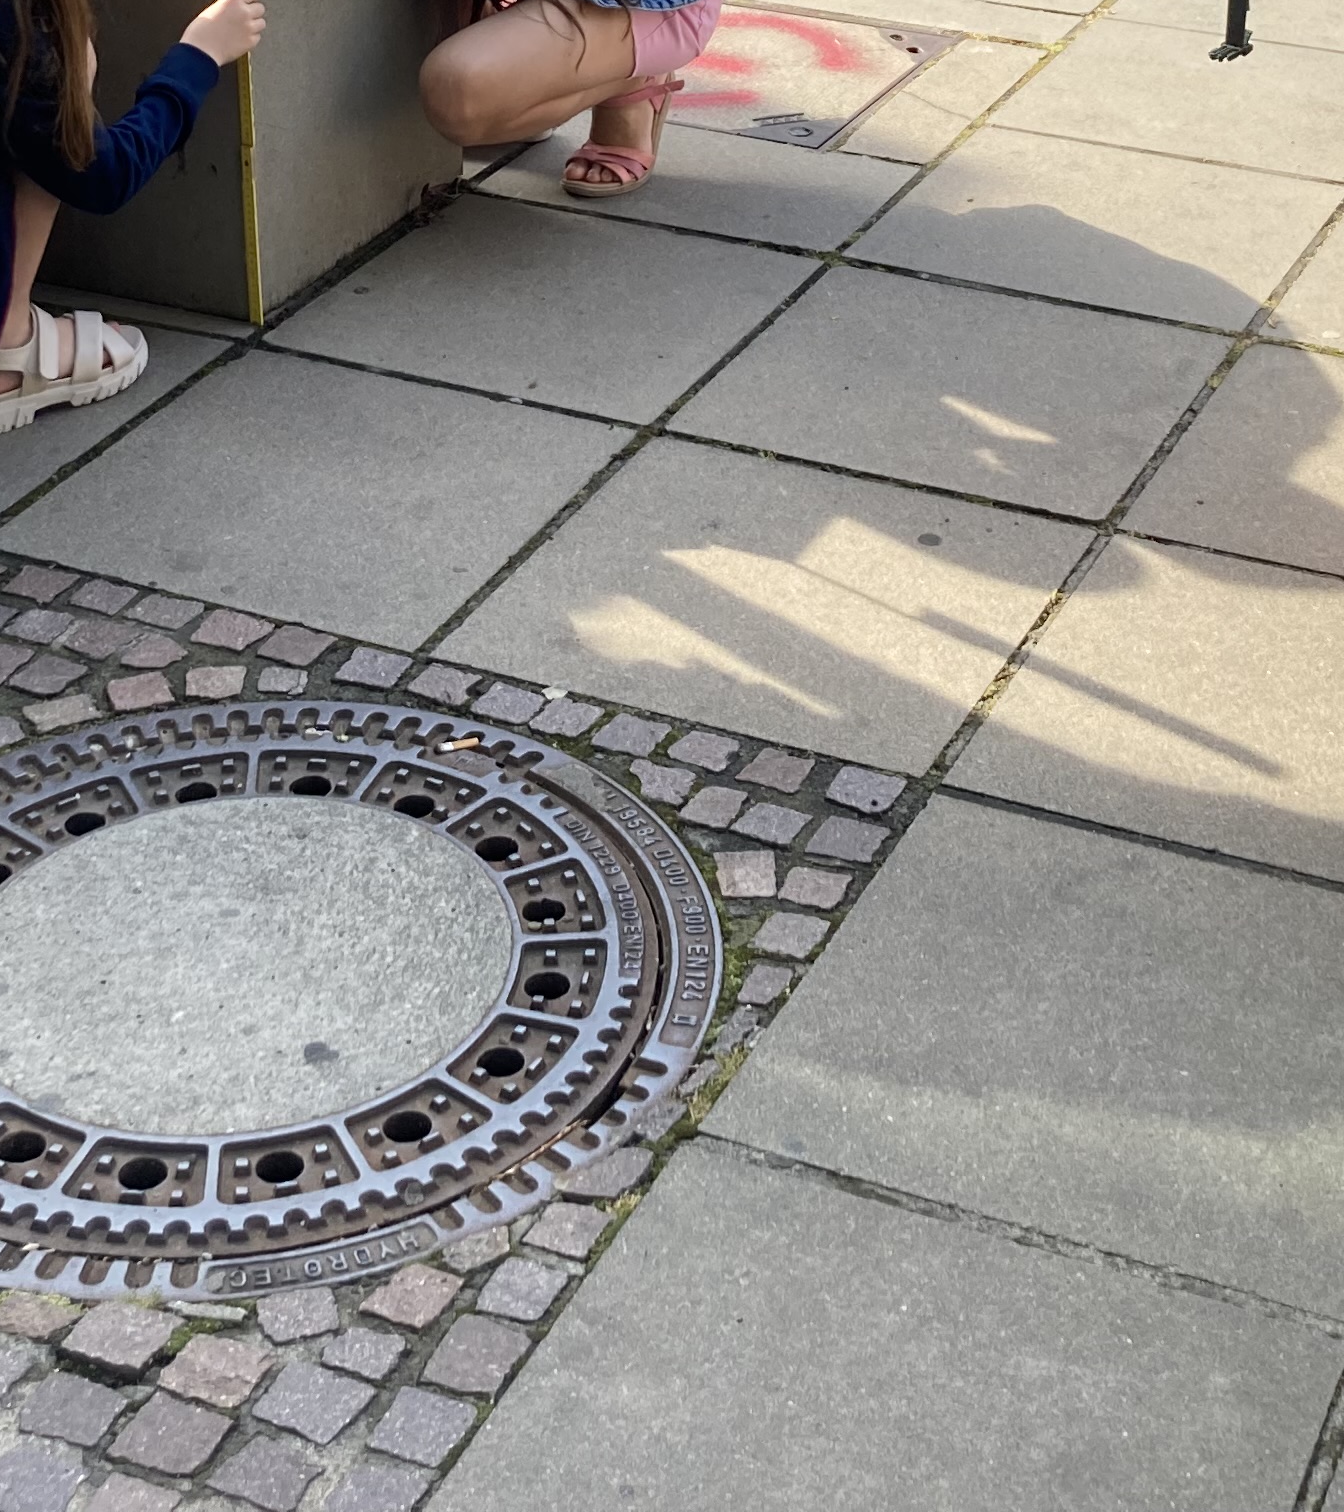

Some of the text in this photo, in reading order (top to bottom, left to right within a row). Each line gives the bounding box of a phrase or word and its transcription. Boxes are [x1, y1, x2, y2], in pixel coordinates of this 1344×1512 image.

[565, 815, 596, 842] DIN
[587, 840, 621, 876] 1229
[612, 804, 662, 847] 19584
[229, 1231, 419, 1288] HYDROTEC
